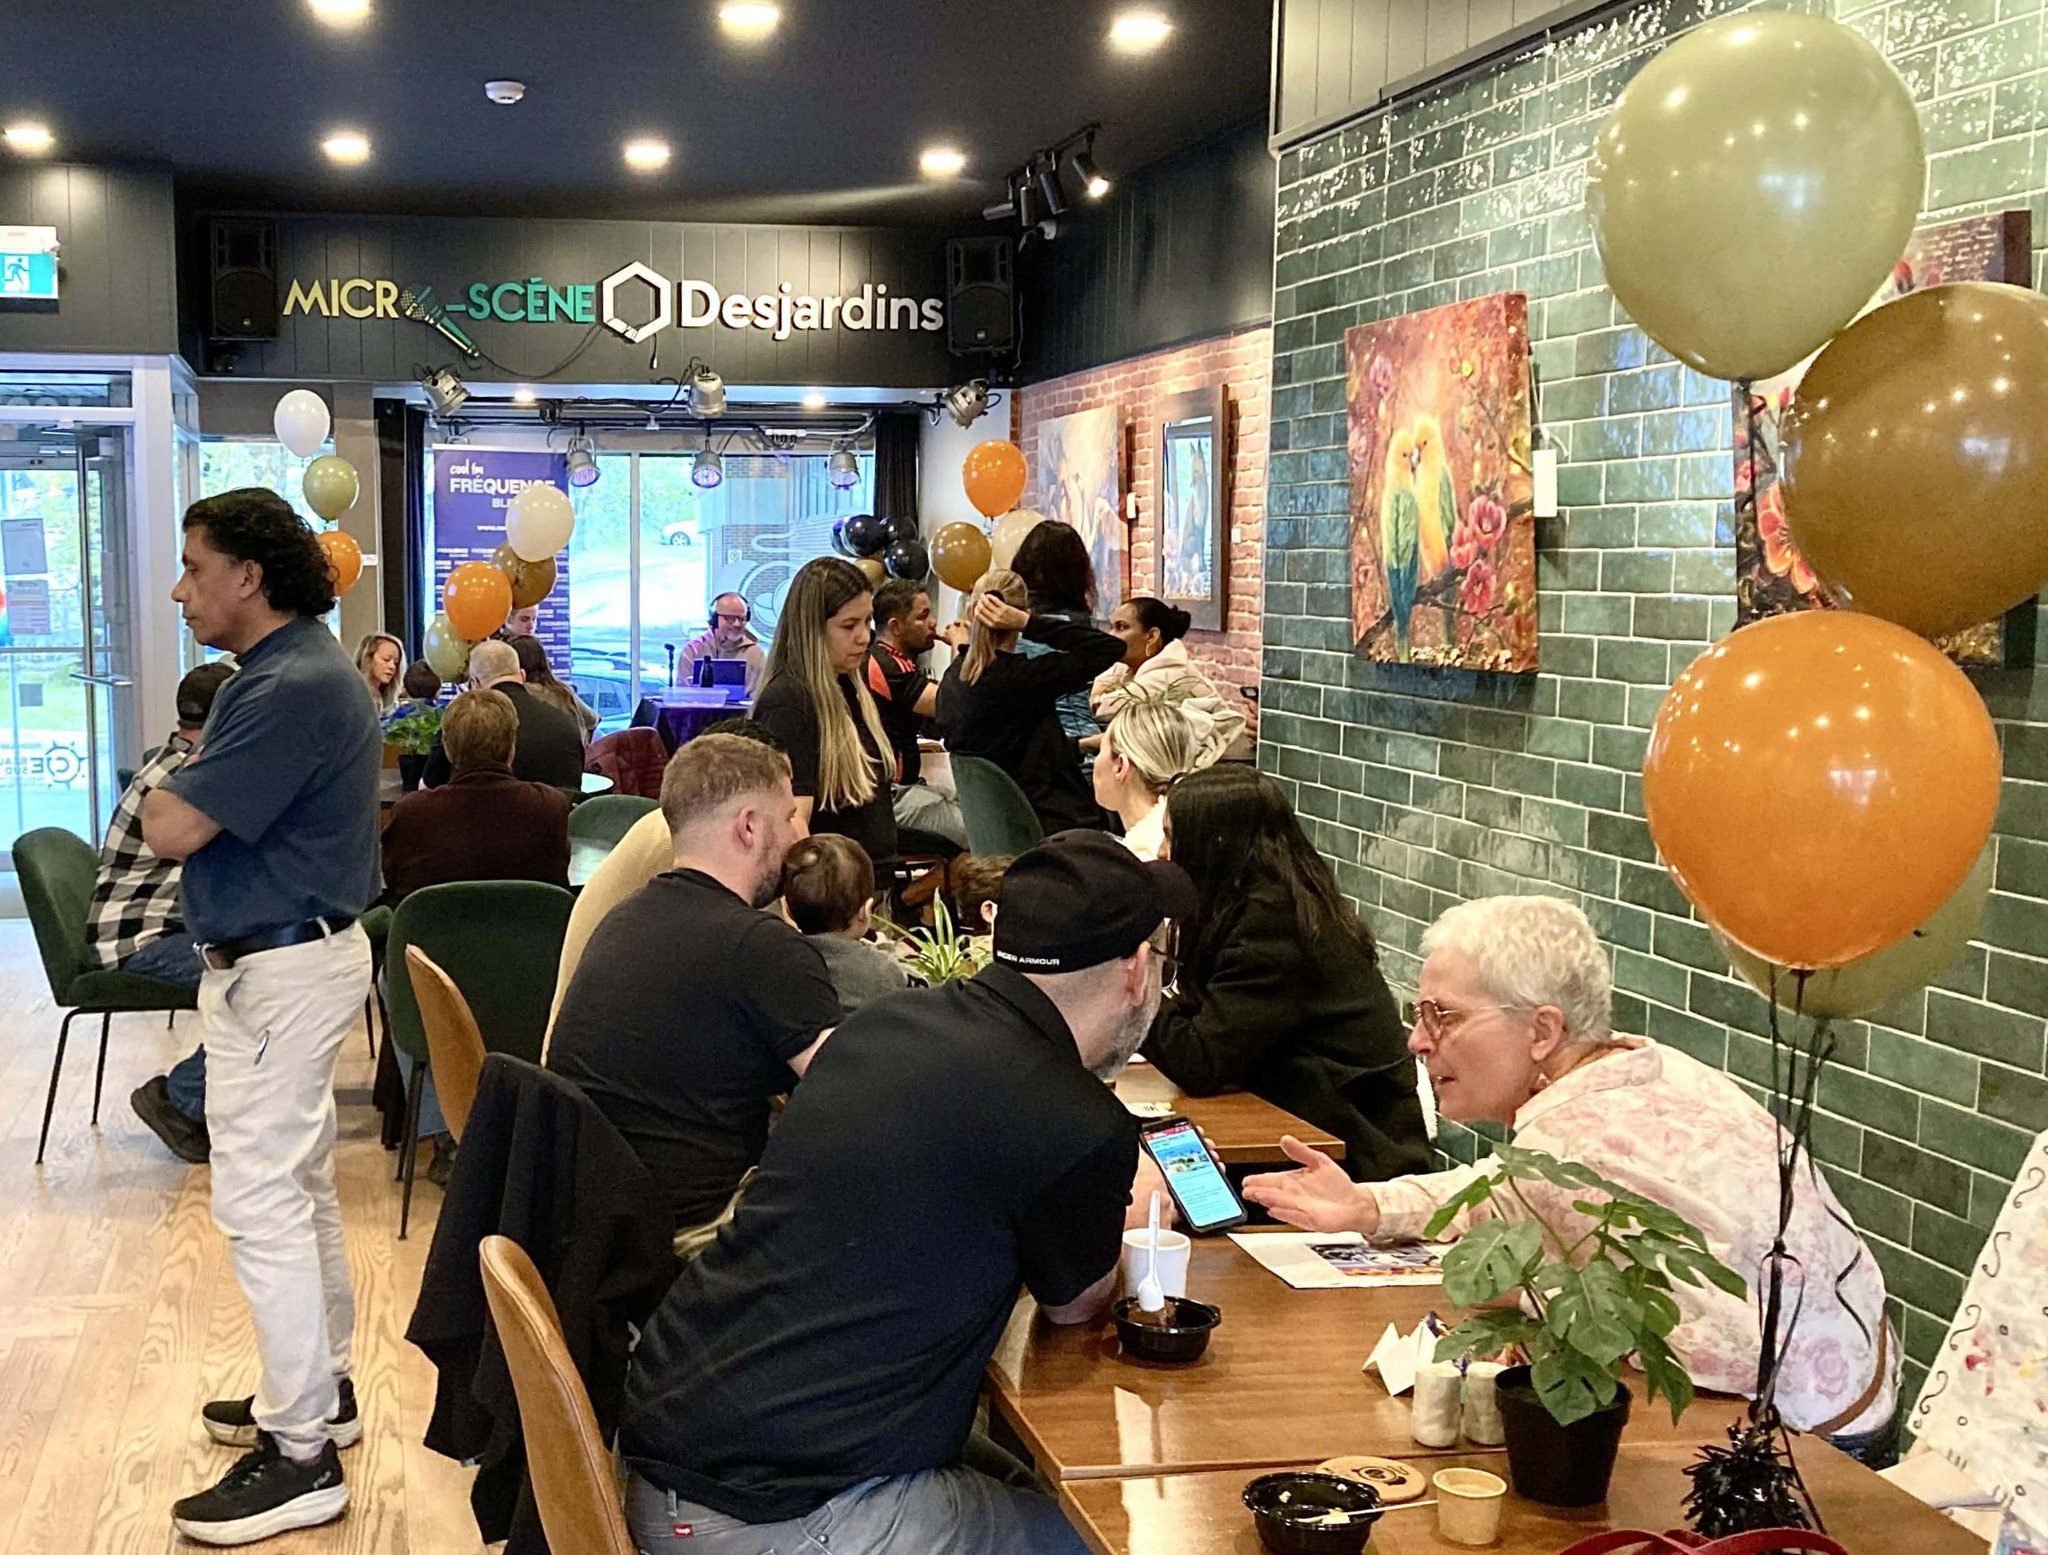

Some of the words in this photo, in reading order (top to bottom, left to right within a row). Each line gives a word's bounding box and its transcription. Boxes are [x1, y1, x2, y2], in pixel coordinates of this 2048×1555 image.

[680, 279, 944, 341] Desjardins
[449, 458, 469, 475] cool
[1019, 957, 1060, 966] ARMOUR
